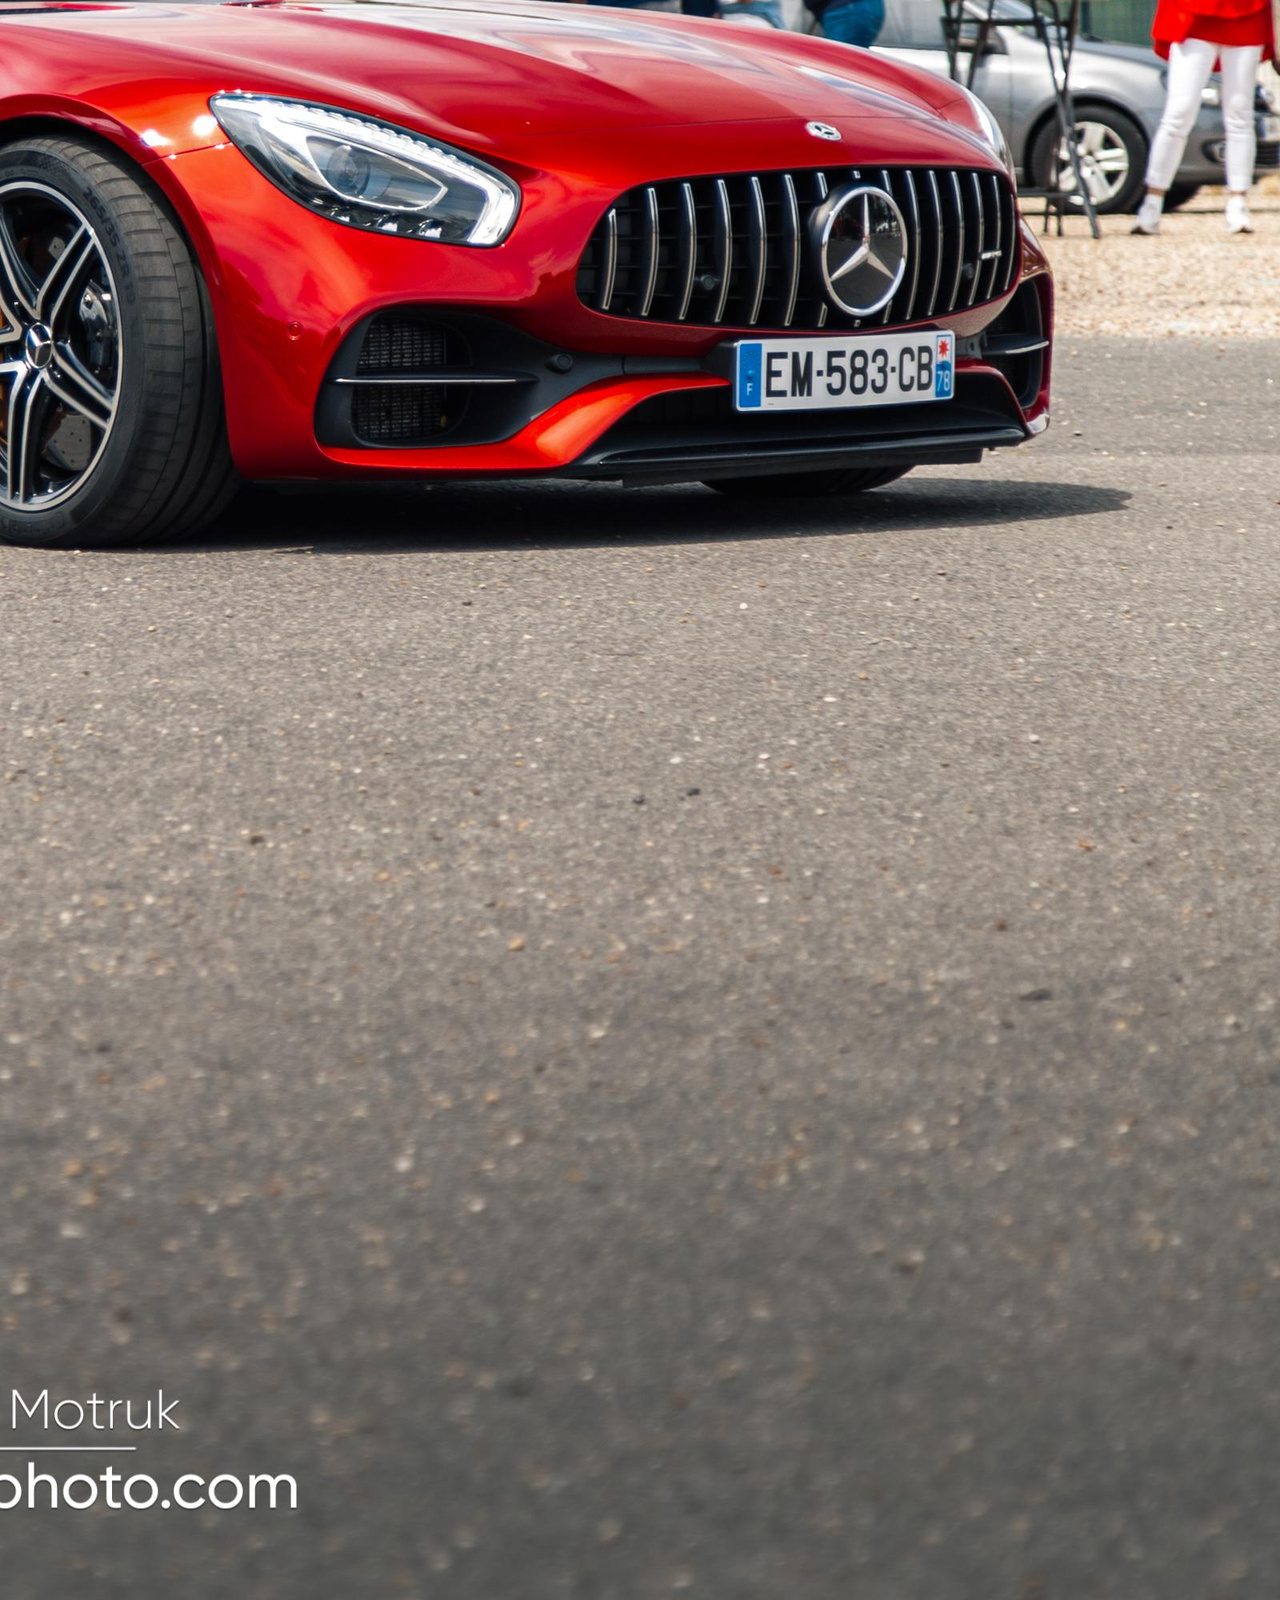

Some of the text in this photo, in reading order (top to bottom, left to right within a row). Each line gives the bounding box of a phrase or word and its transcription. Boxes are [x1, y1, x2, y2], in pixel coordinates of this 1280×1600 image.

[765, 345, 934, 398] EM-583-CB
[936, 369, 951, 392] 78
[746, 382, 754, 397] F
